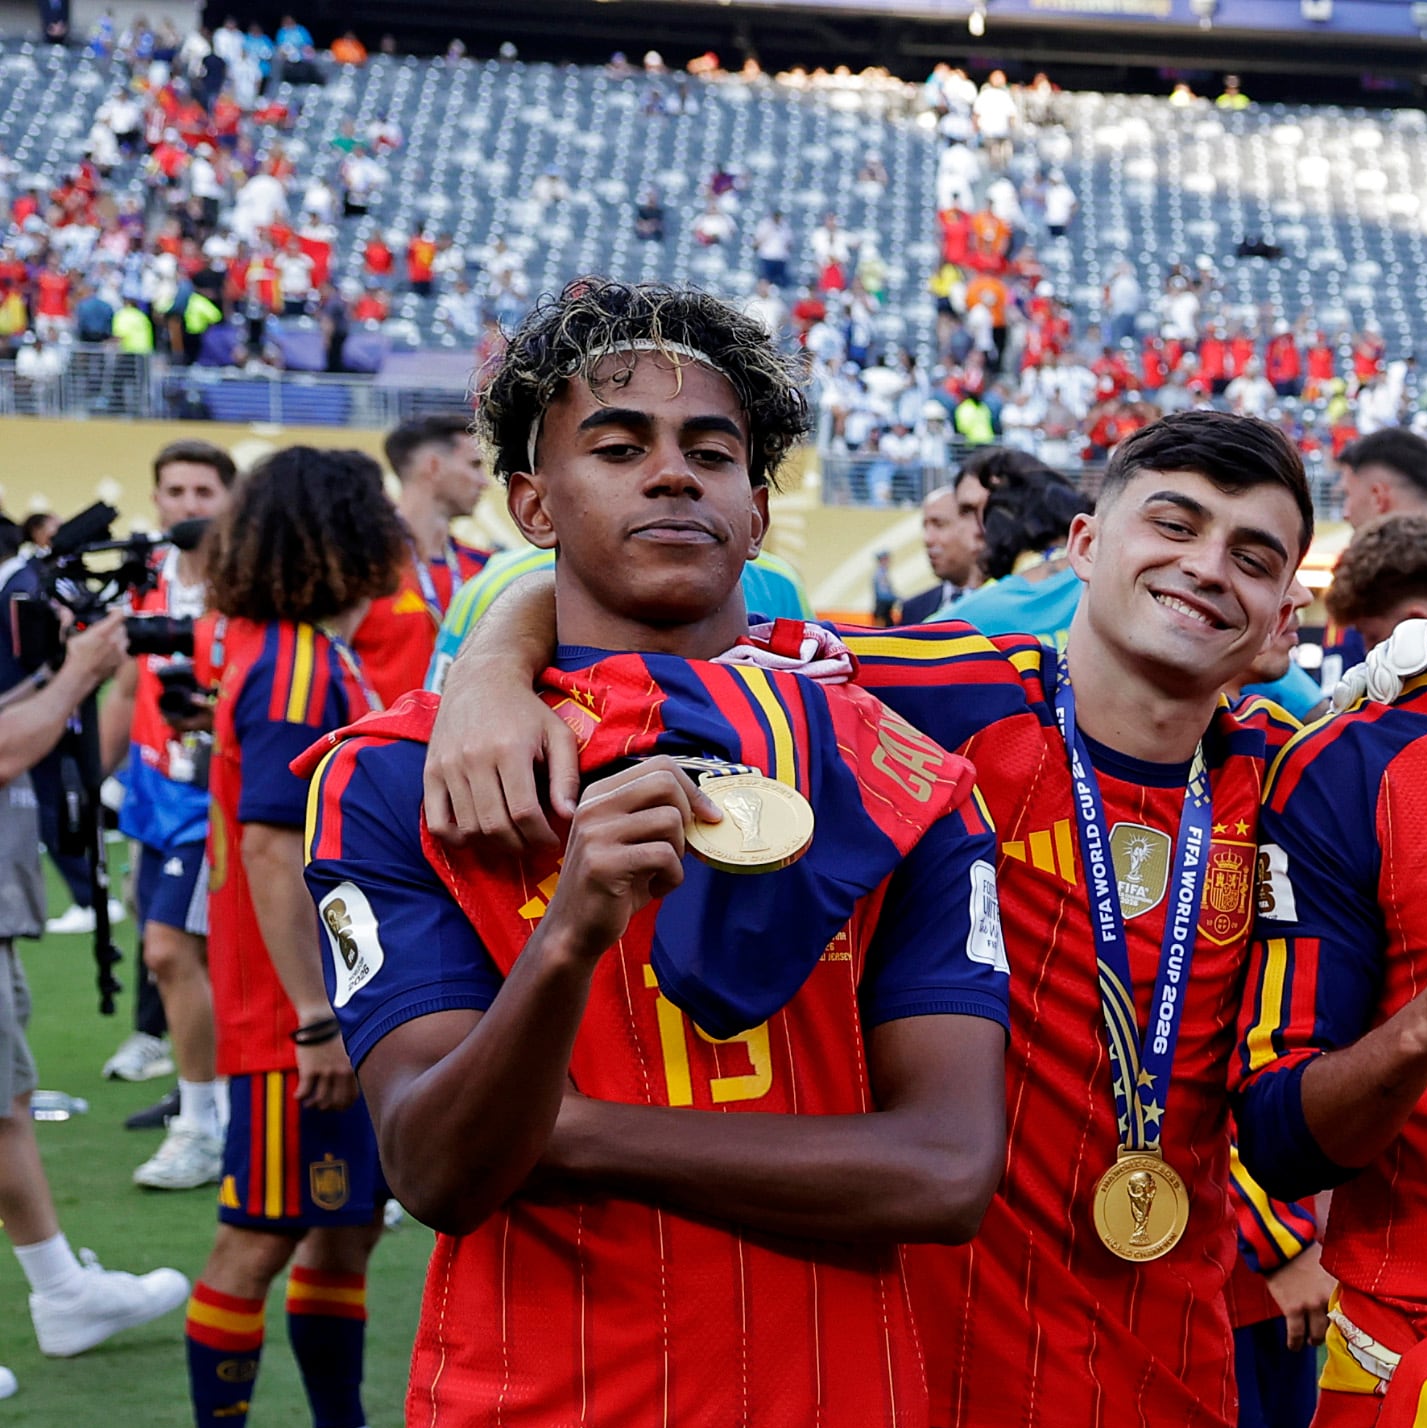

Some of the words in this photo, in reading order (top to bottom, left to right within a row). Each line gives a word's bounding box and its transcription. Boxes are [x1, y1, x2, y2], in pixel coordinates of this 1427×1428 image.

[1076, 782, 1096, 822] CUP
[1085, 824, 1112, 898] WORLD
[1183, 826, 1203, 868] FIFA
[1118, 881, 1146, 897] FIFA
[1173, 871, 1197, 940] WORLD
[1102, 899, 1116, 942] FIFA
[1167, 944, 1184, 983] CUP
[1153, 985, 1177, 1055] 2026
